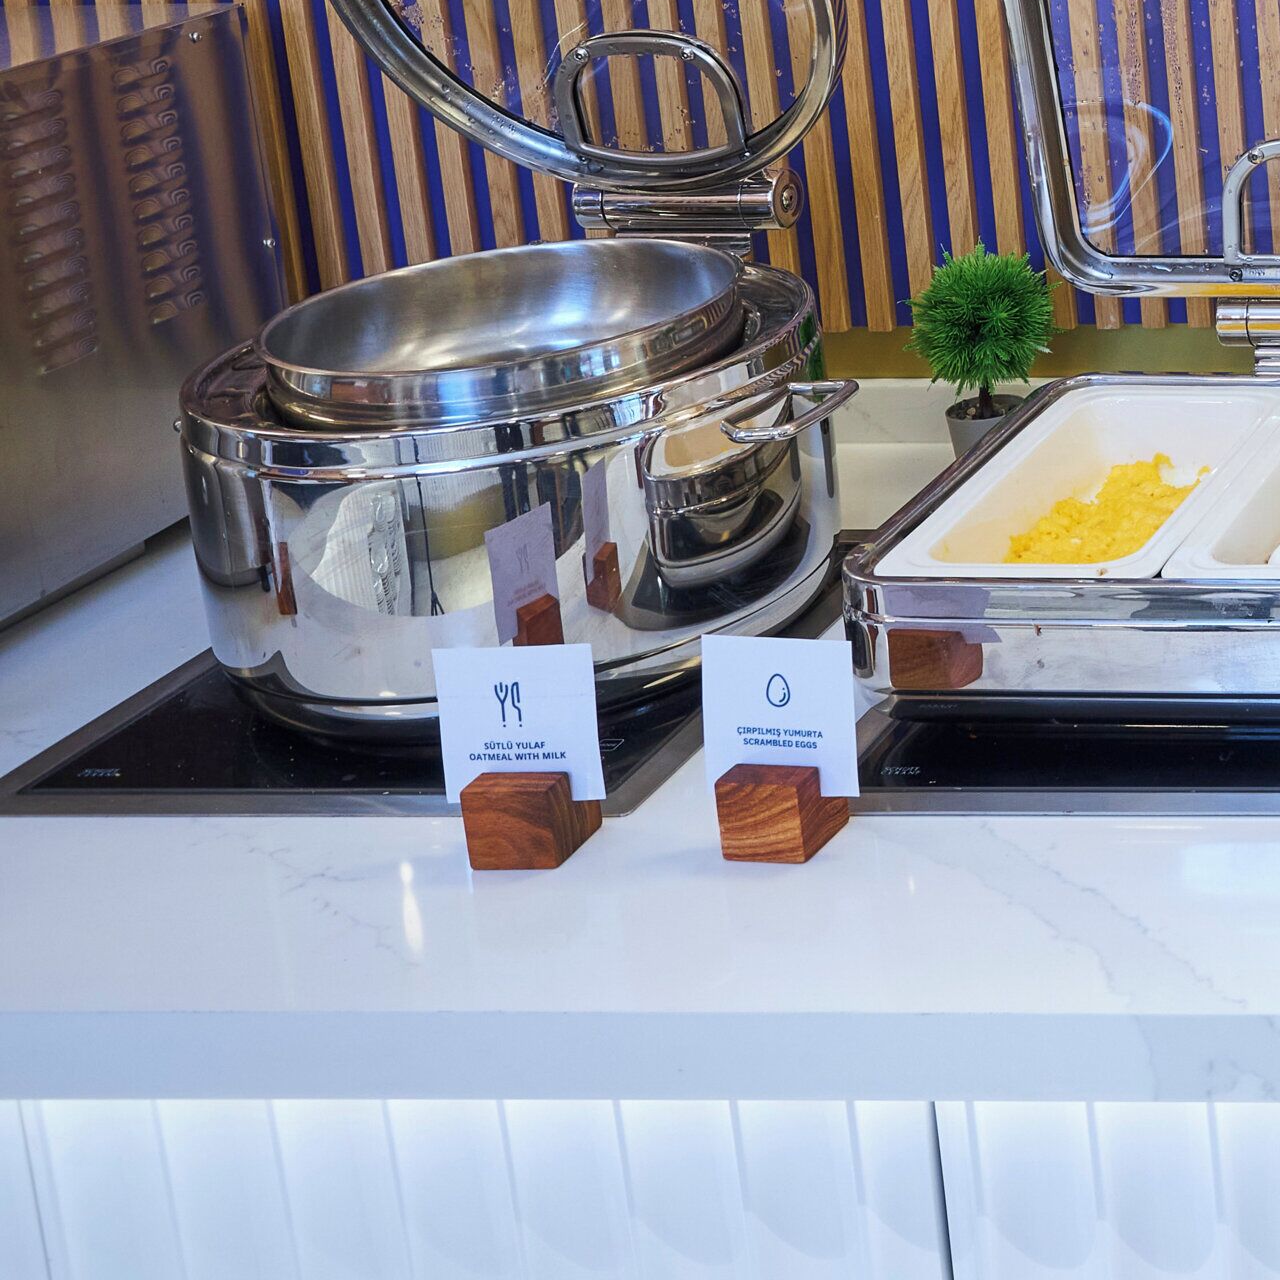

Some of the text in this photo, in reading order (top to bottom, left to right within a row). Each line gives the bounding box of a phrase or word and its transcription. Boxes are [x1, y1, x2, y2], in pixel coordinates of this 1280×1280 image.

[737, 726, 823, 738] ÇIRPILMIŞ YUMURTA
[484, 740, 545, 750] SÜTLÜ YULAF
[743, 738, 817, 749] SCRAMBLED EGGS
[469, 750, 567, 761] OATMEAL WITH MILK
